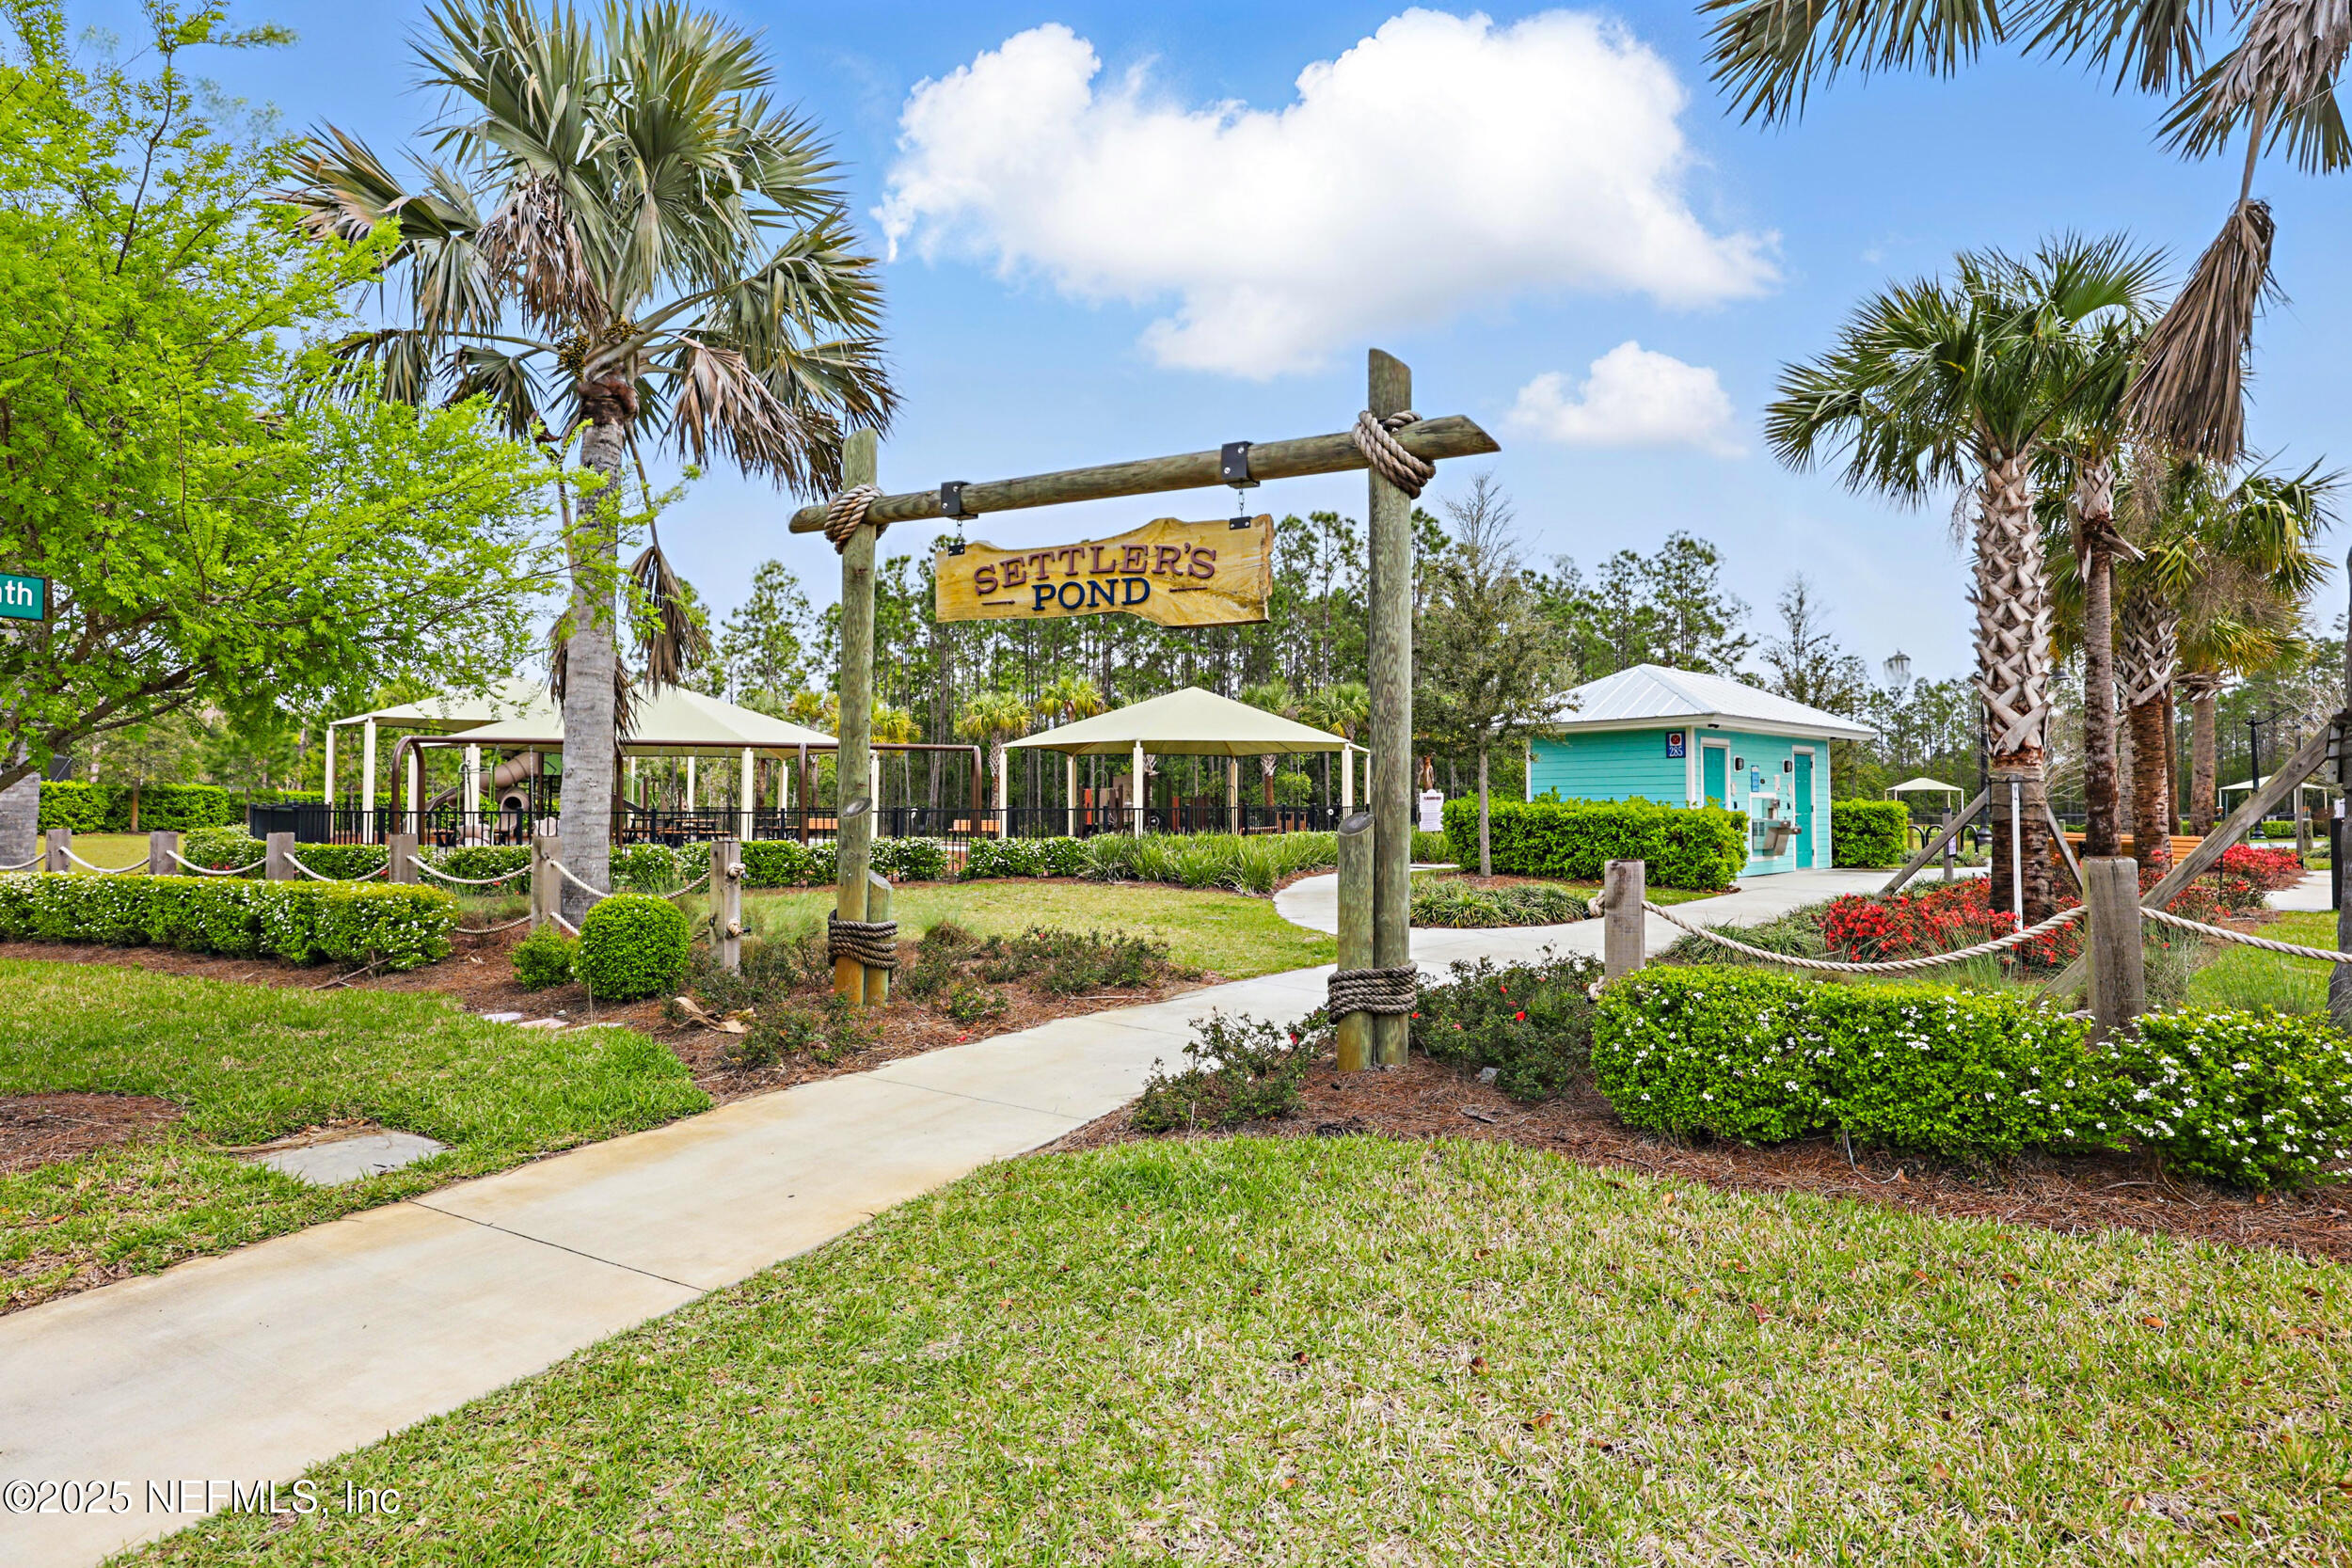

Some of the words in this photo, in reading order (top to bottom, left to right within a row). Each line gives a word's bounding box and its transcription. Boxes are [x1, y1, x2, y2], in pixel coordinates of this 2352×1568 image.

[975, 543, 1216, 595] SETTLER'S
[0, 579, 33, 607] th
[1031, 577, 1151, 611] POND
